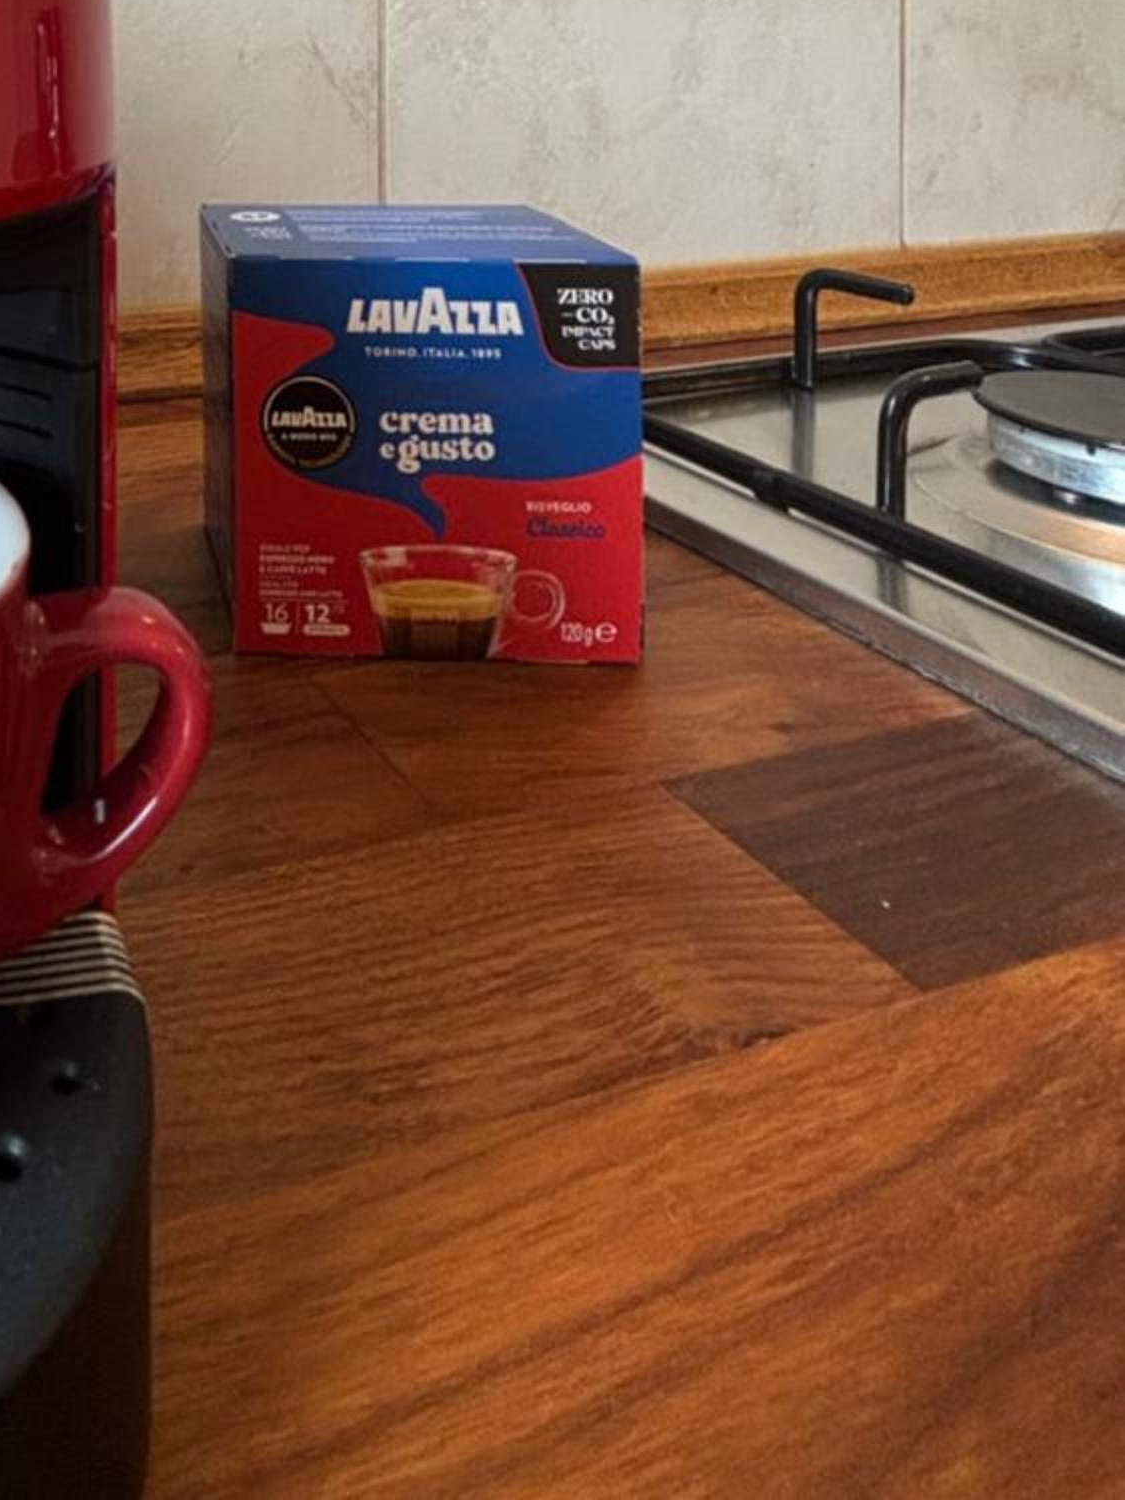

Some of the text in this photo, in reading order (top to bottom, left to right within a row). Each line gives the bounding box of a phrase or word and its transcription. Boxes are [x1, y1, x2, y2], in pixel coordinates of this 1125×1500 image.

[556, 287, 614, 305] ZERO
[346, 286, 525, 336] LAVAZZA
[577, 339, 616, 351] CAPS
[271, 405, 347, 428] LAVAZZA
[379, 411, 494, 434] crema
[379, 434, 495, 474] e gusto
[263, 602, 289, 621] 16
[304, 603, 331, 623] 12
